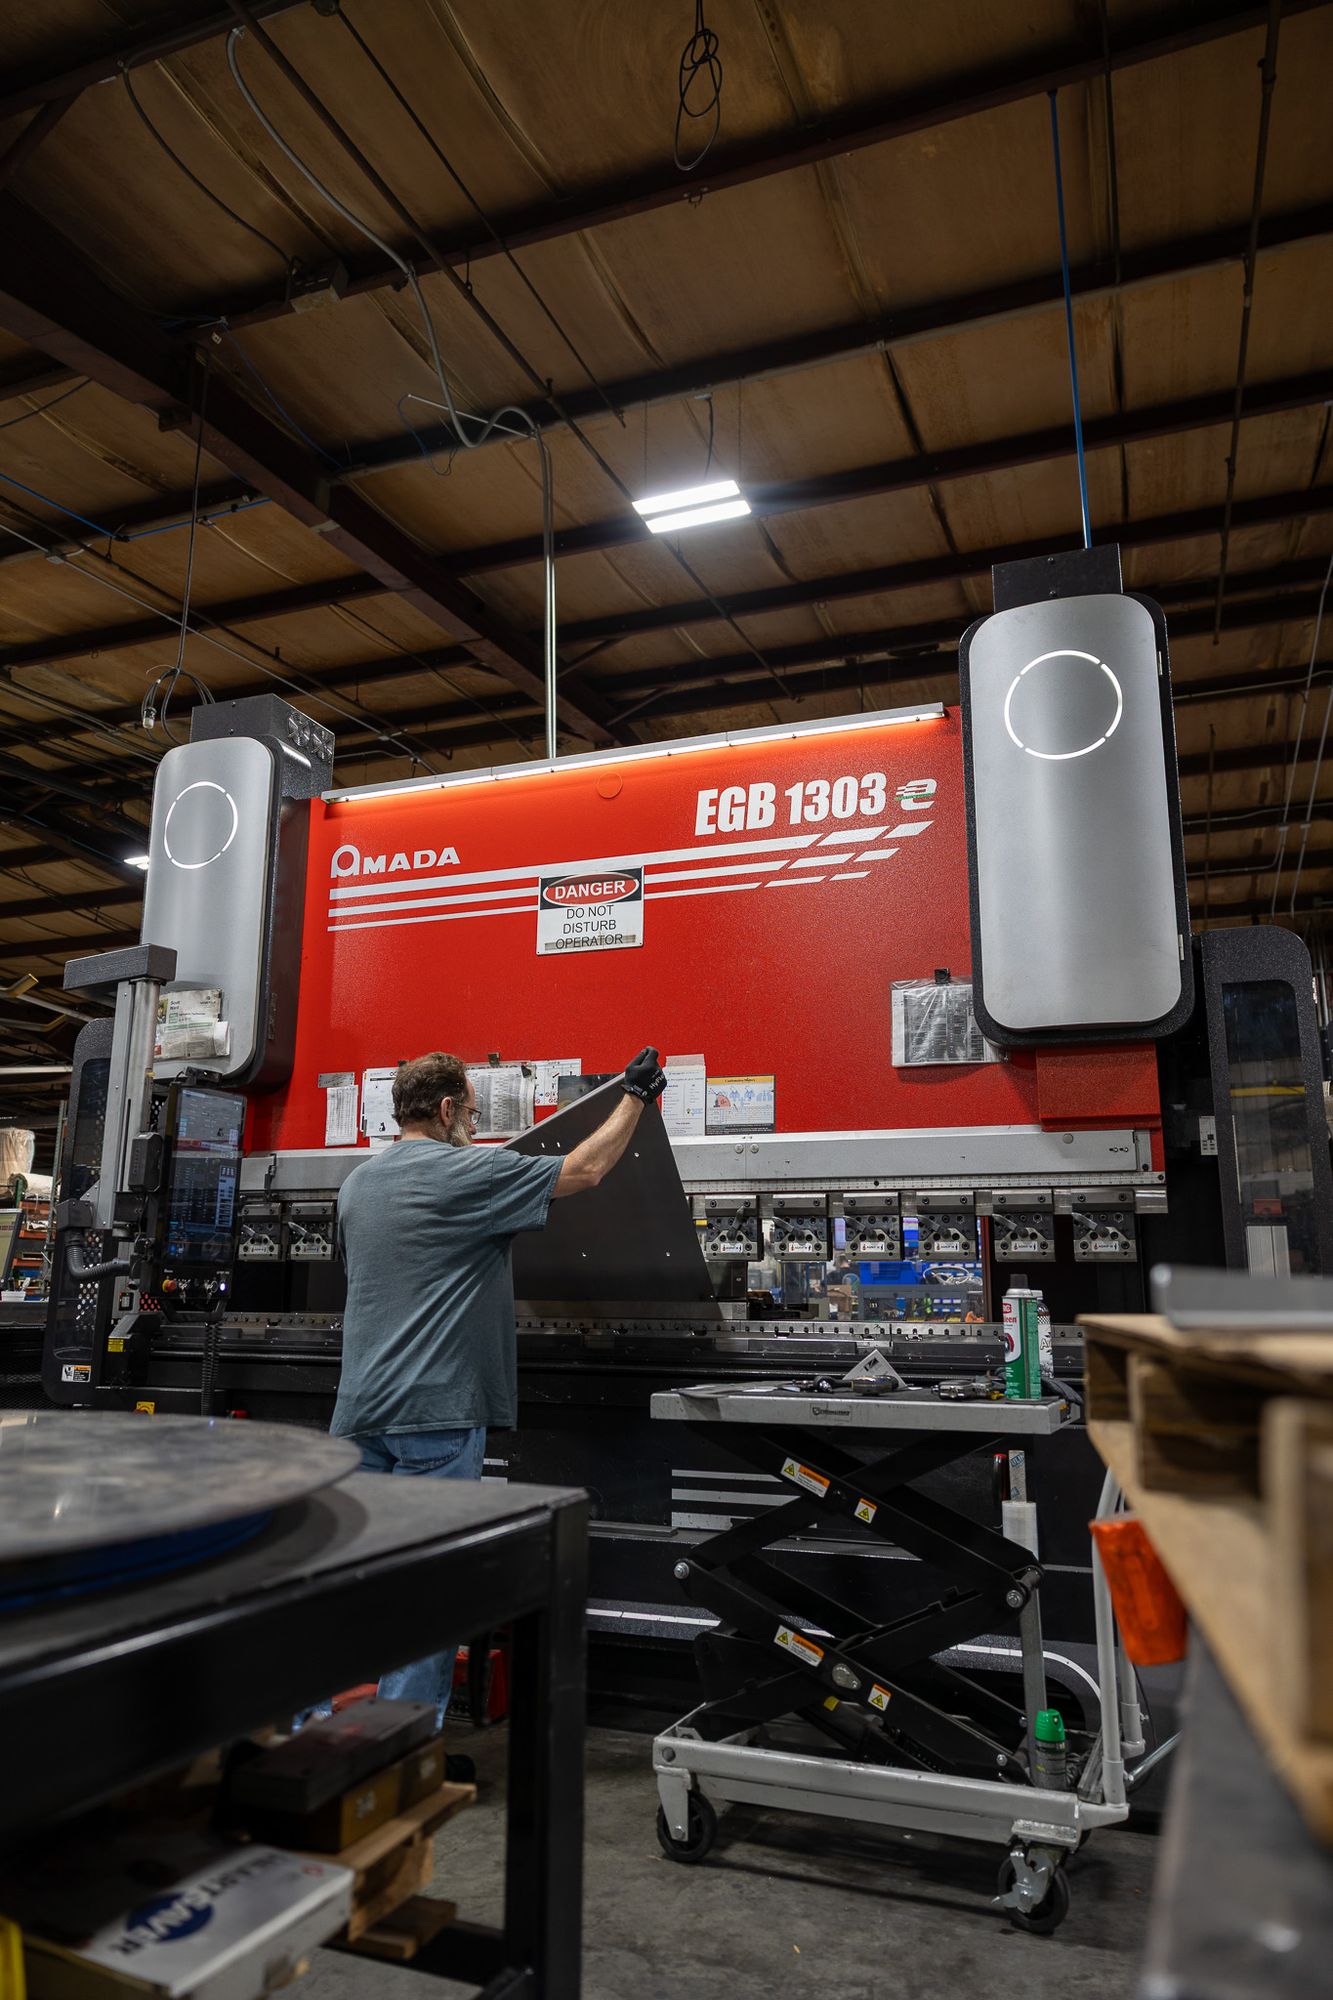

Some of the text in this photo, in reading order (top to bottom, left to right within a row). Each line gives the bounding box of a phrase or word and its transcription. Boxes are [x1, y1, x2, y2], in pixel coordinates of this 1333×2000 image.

[694, 781, 776, 836] EGB
[785, 772, 886, 825] 1303
[330, 844, 461, 878] AMADA
[555, 880, 626, 900] DANGER
[566, 904, 614, 919] DO NOT
[563, 919, 617, 935] DISTURB
[555, 933, 624, 950] OPERATOR
